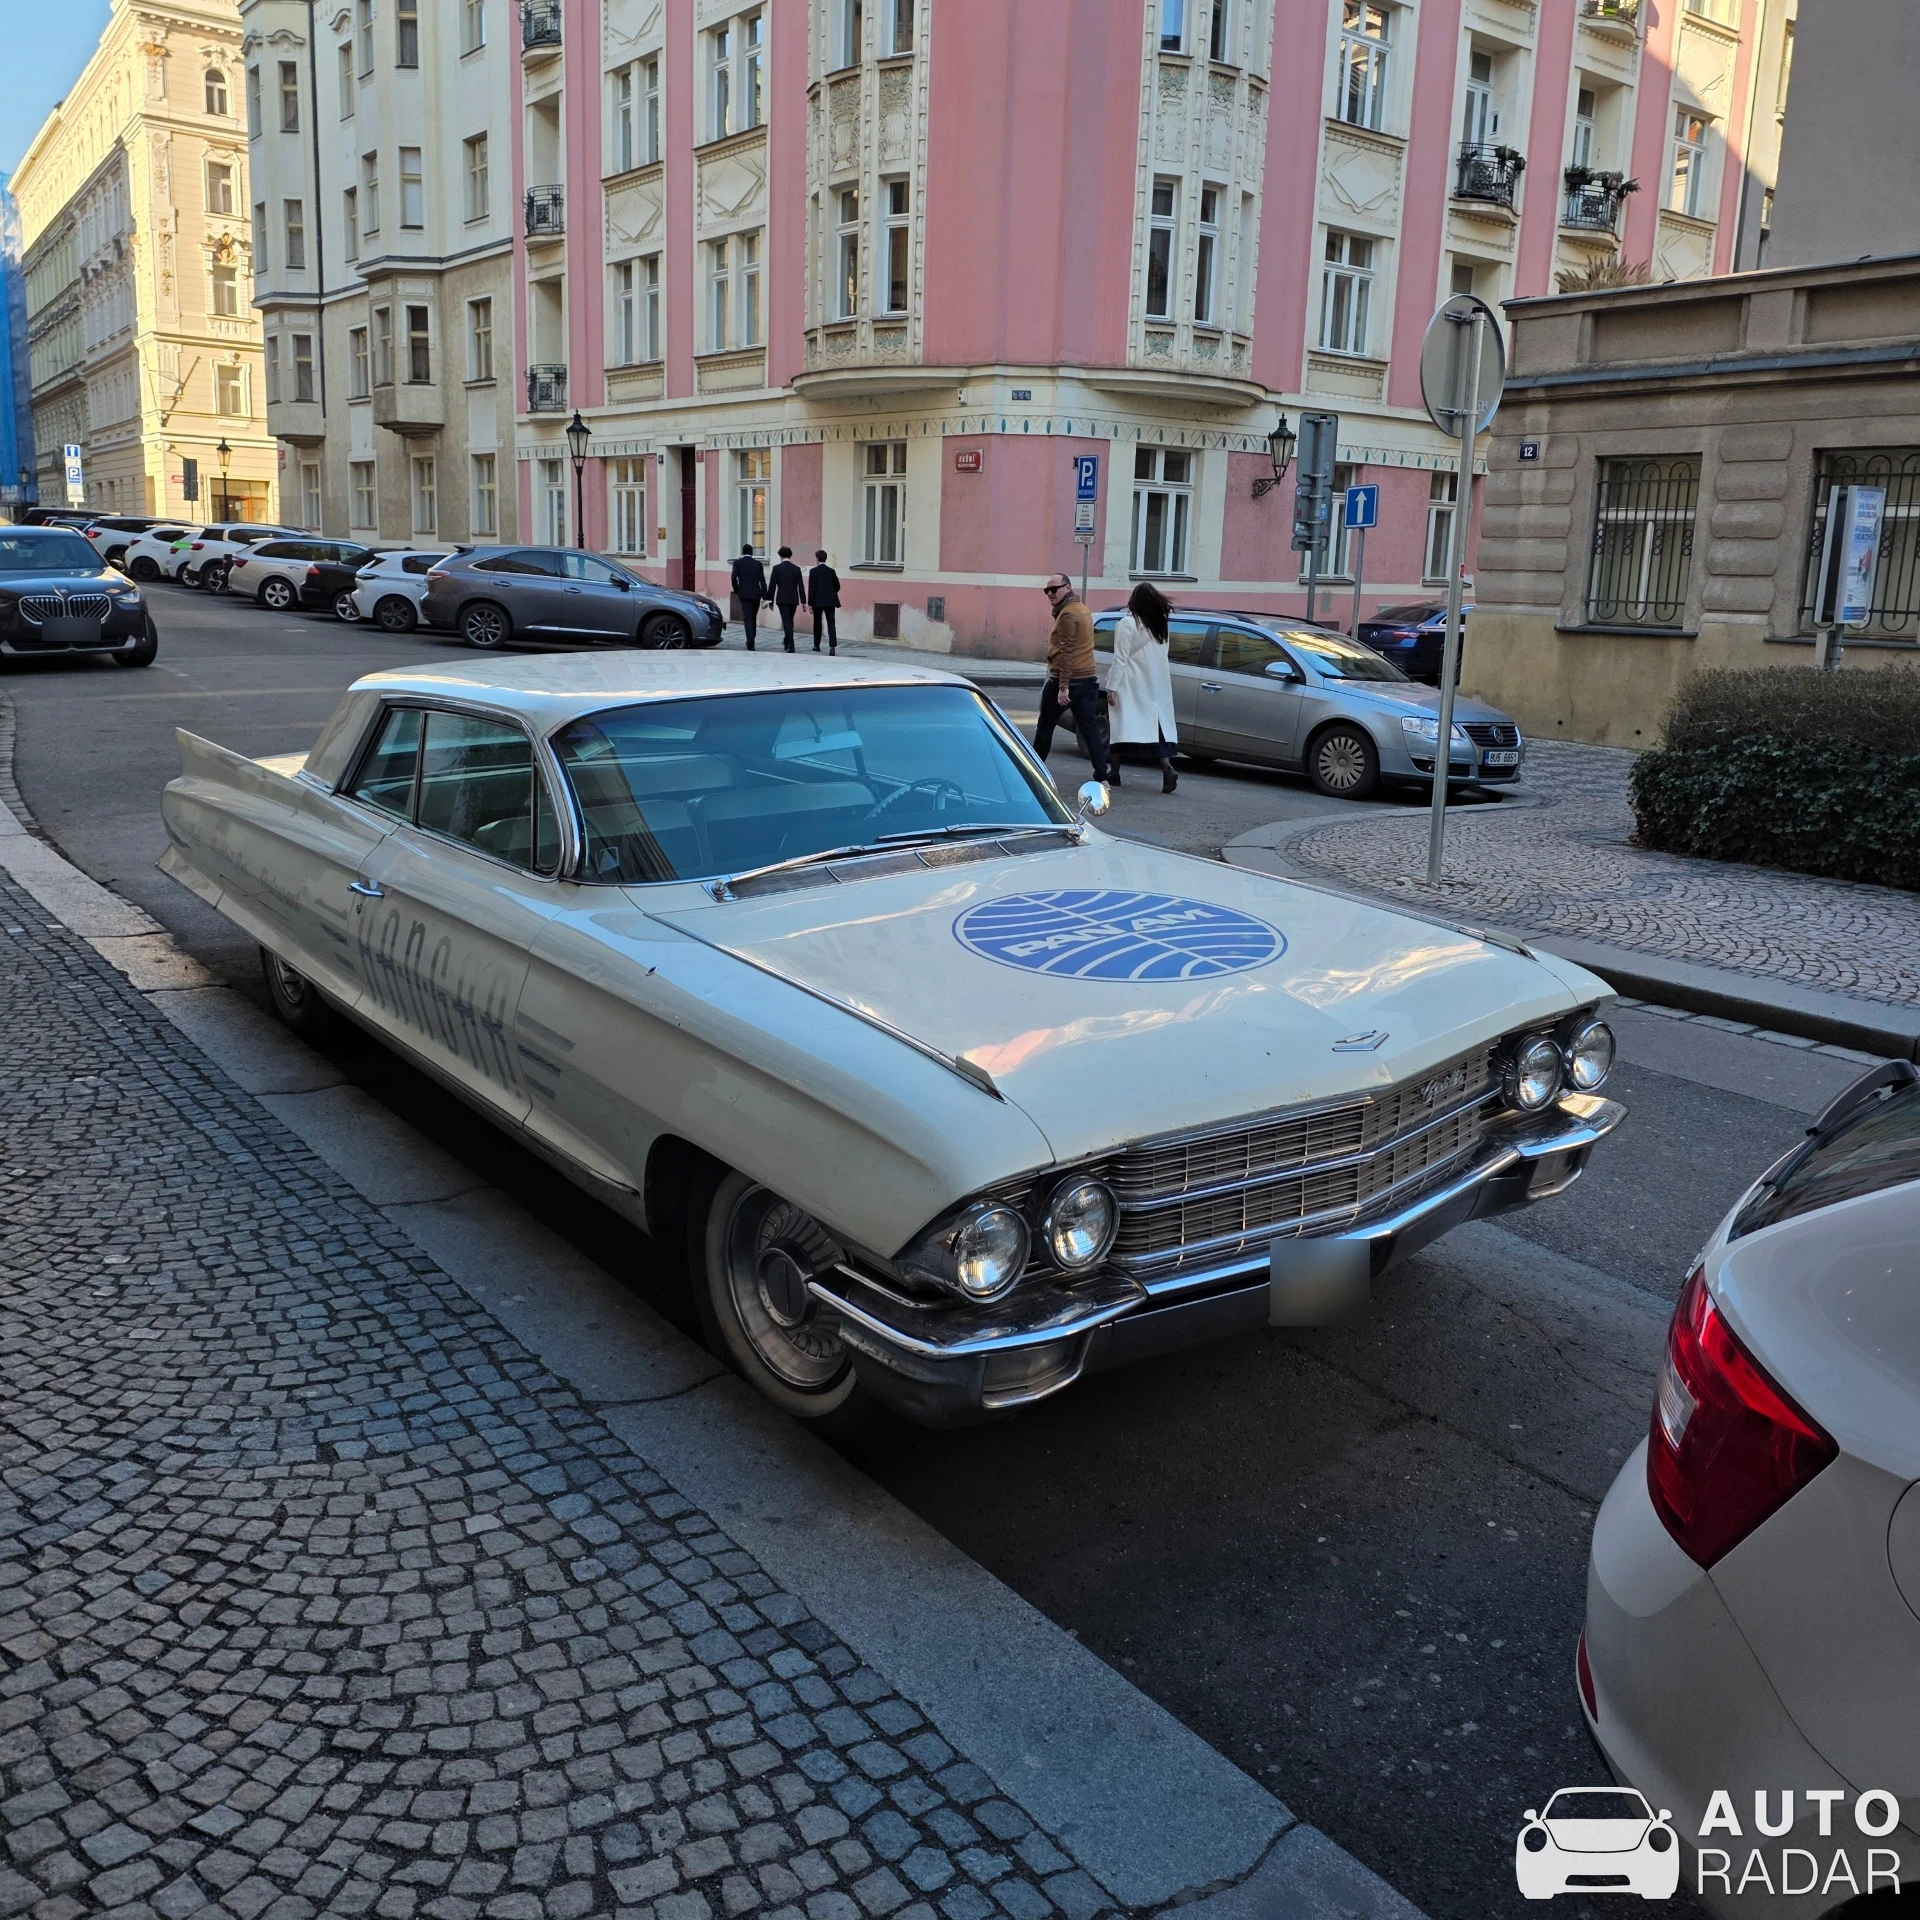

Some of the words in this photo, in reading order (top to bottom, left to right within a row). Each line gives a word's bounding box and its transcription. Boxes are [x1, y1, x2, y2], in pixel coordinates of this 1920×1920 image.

[1524, 446, 1534, 457] 12
[1081, 461, 1094, 487] P
[1000, 923, 1127, 958] PAN
[1131, 907, 1223, 932] AM
